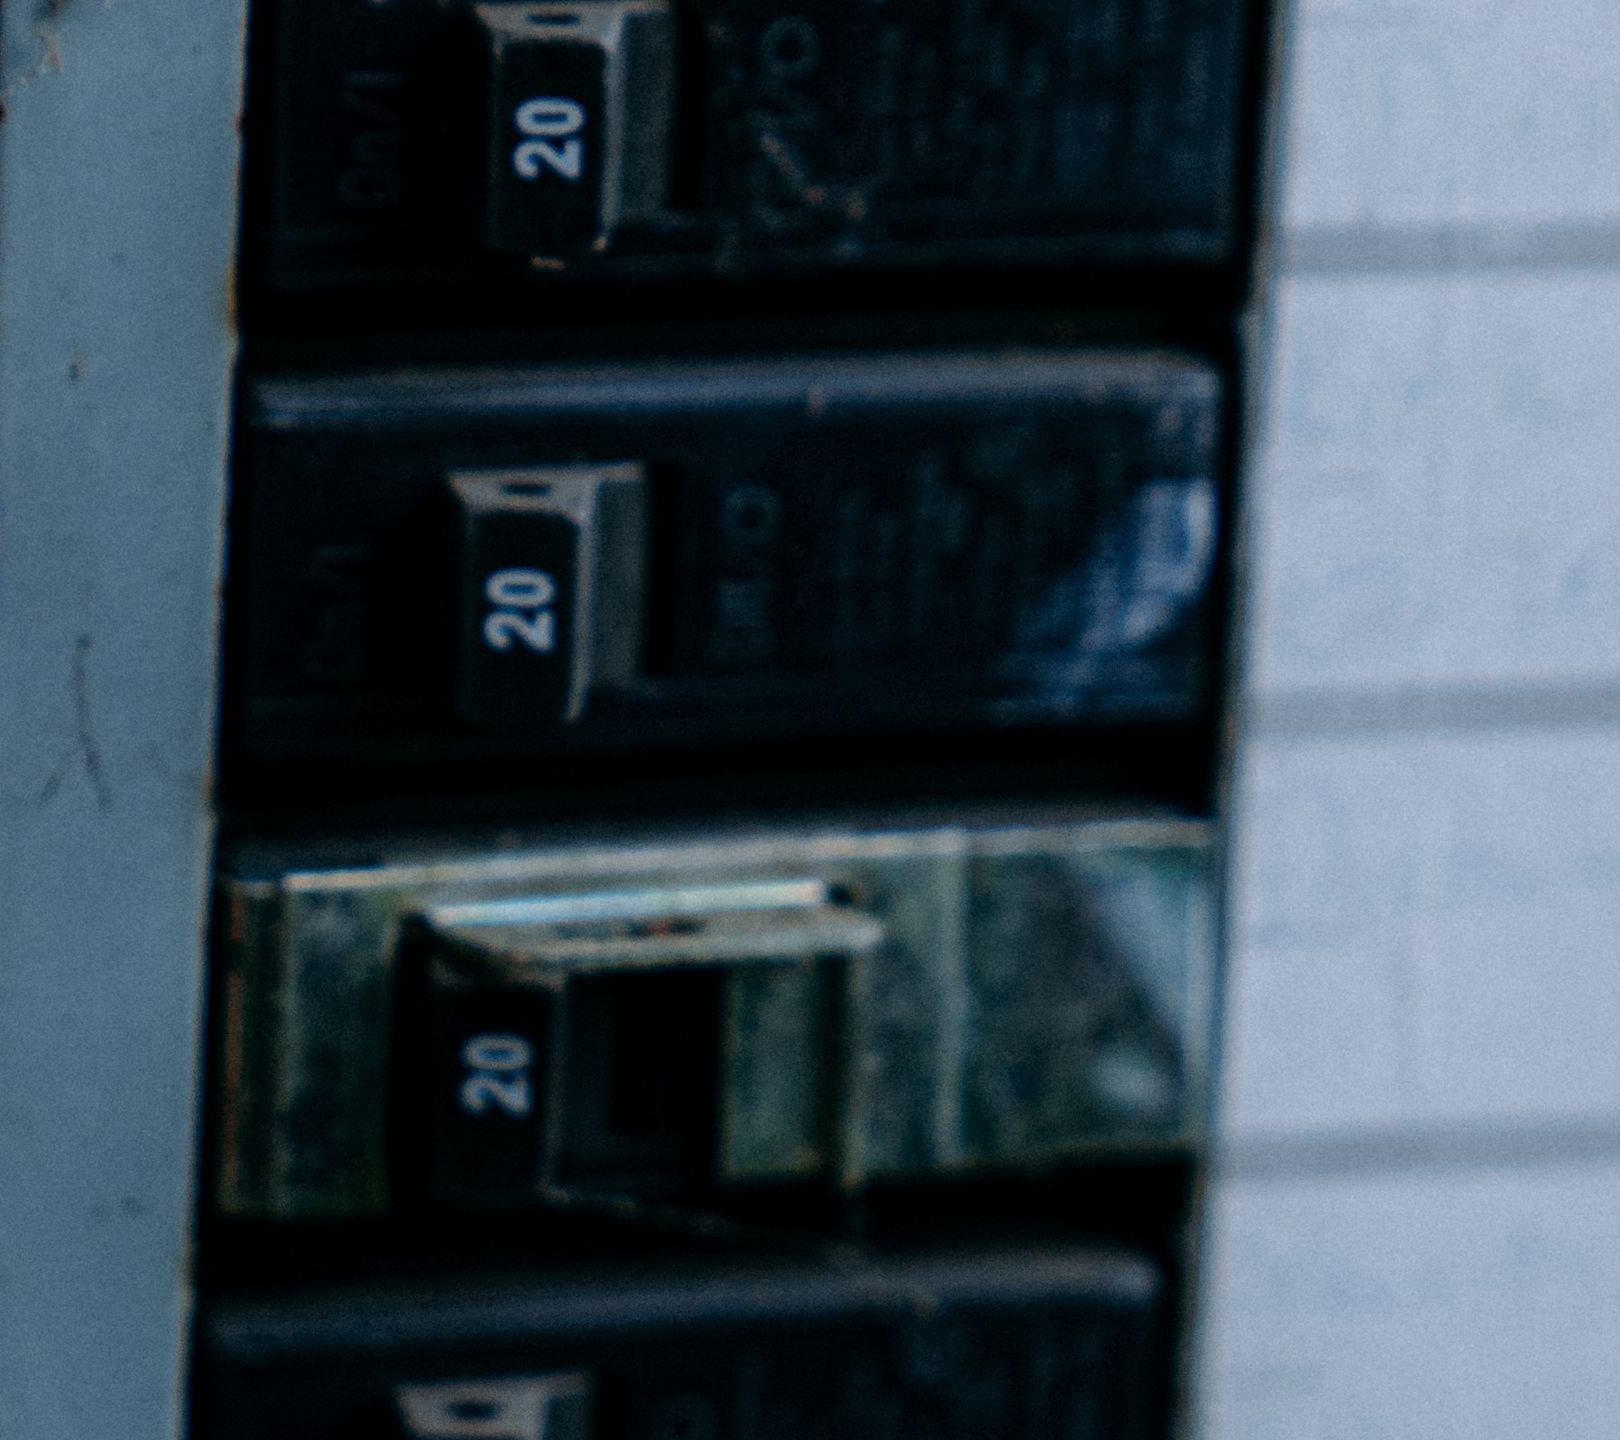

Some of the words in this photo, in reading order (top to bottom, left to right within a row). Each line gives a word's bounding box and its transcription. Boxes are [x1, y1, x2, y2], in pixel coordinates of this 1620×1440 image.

[510, 96, 587, 182] 20
[481, 565, 558, 654] 20
[458, 1028, 538, 1120] 20
